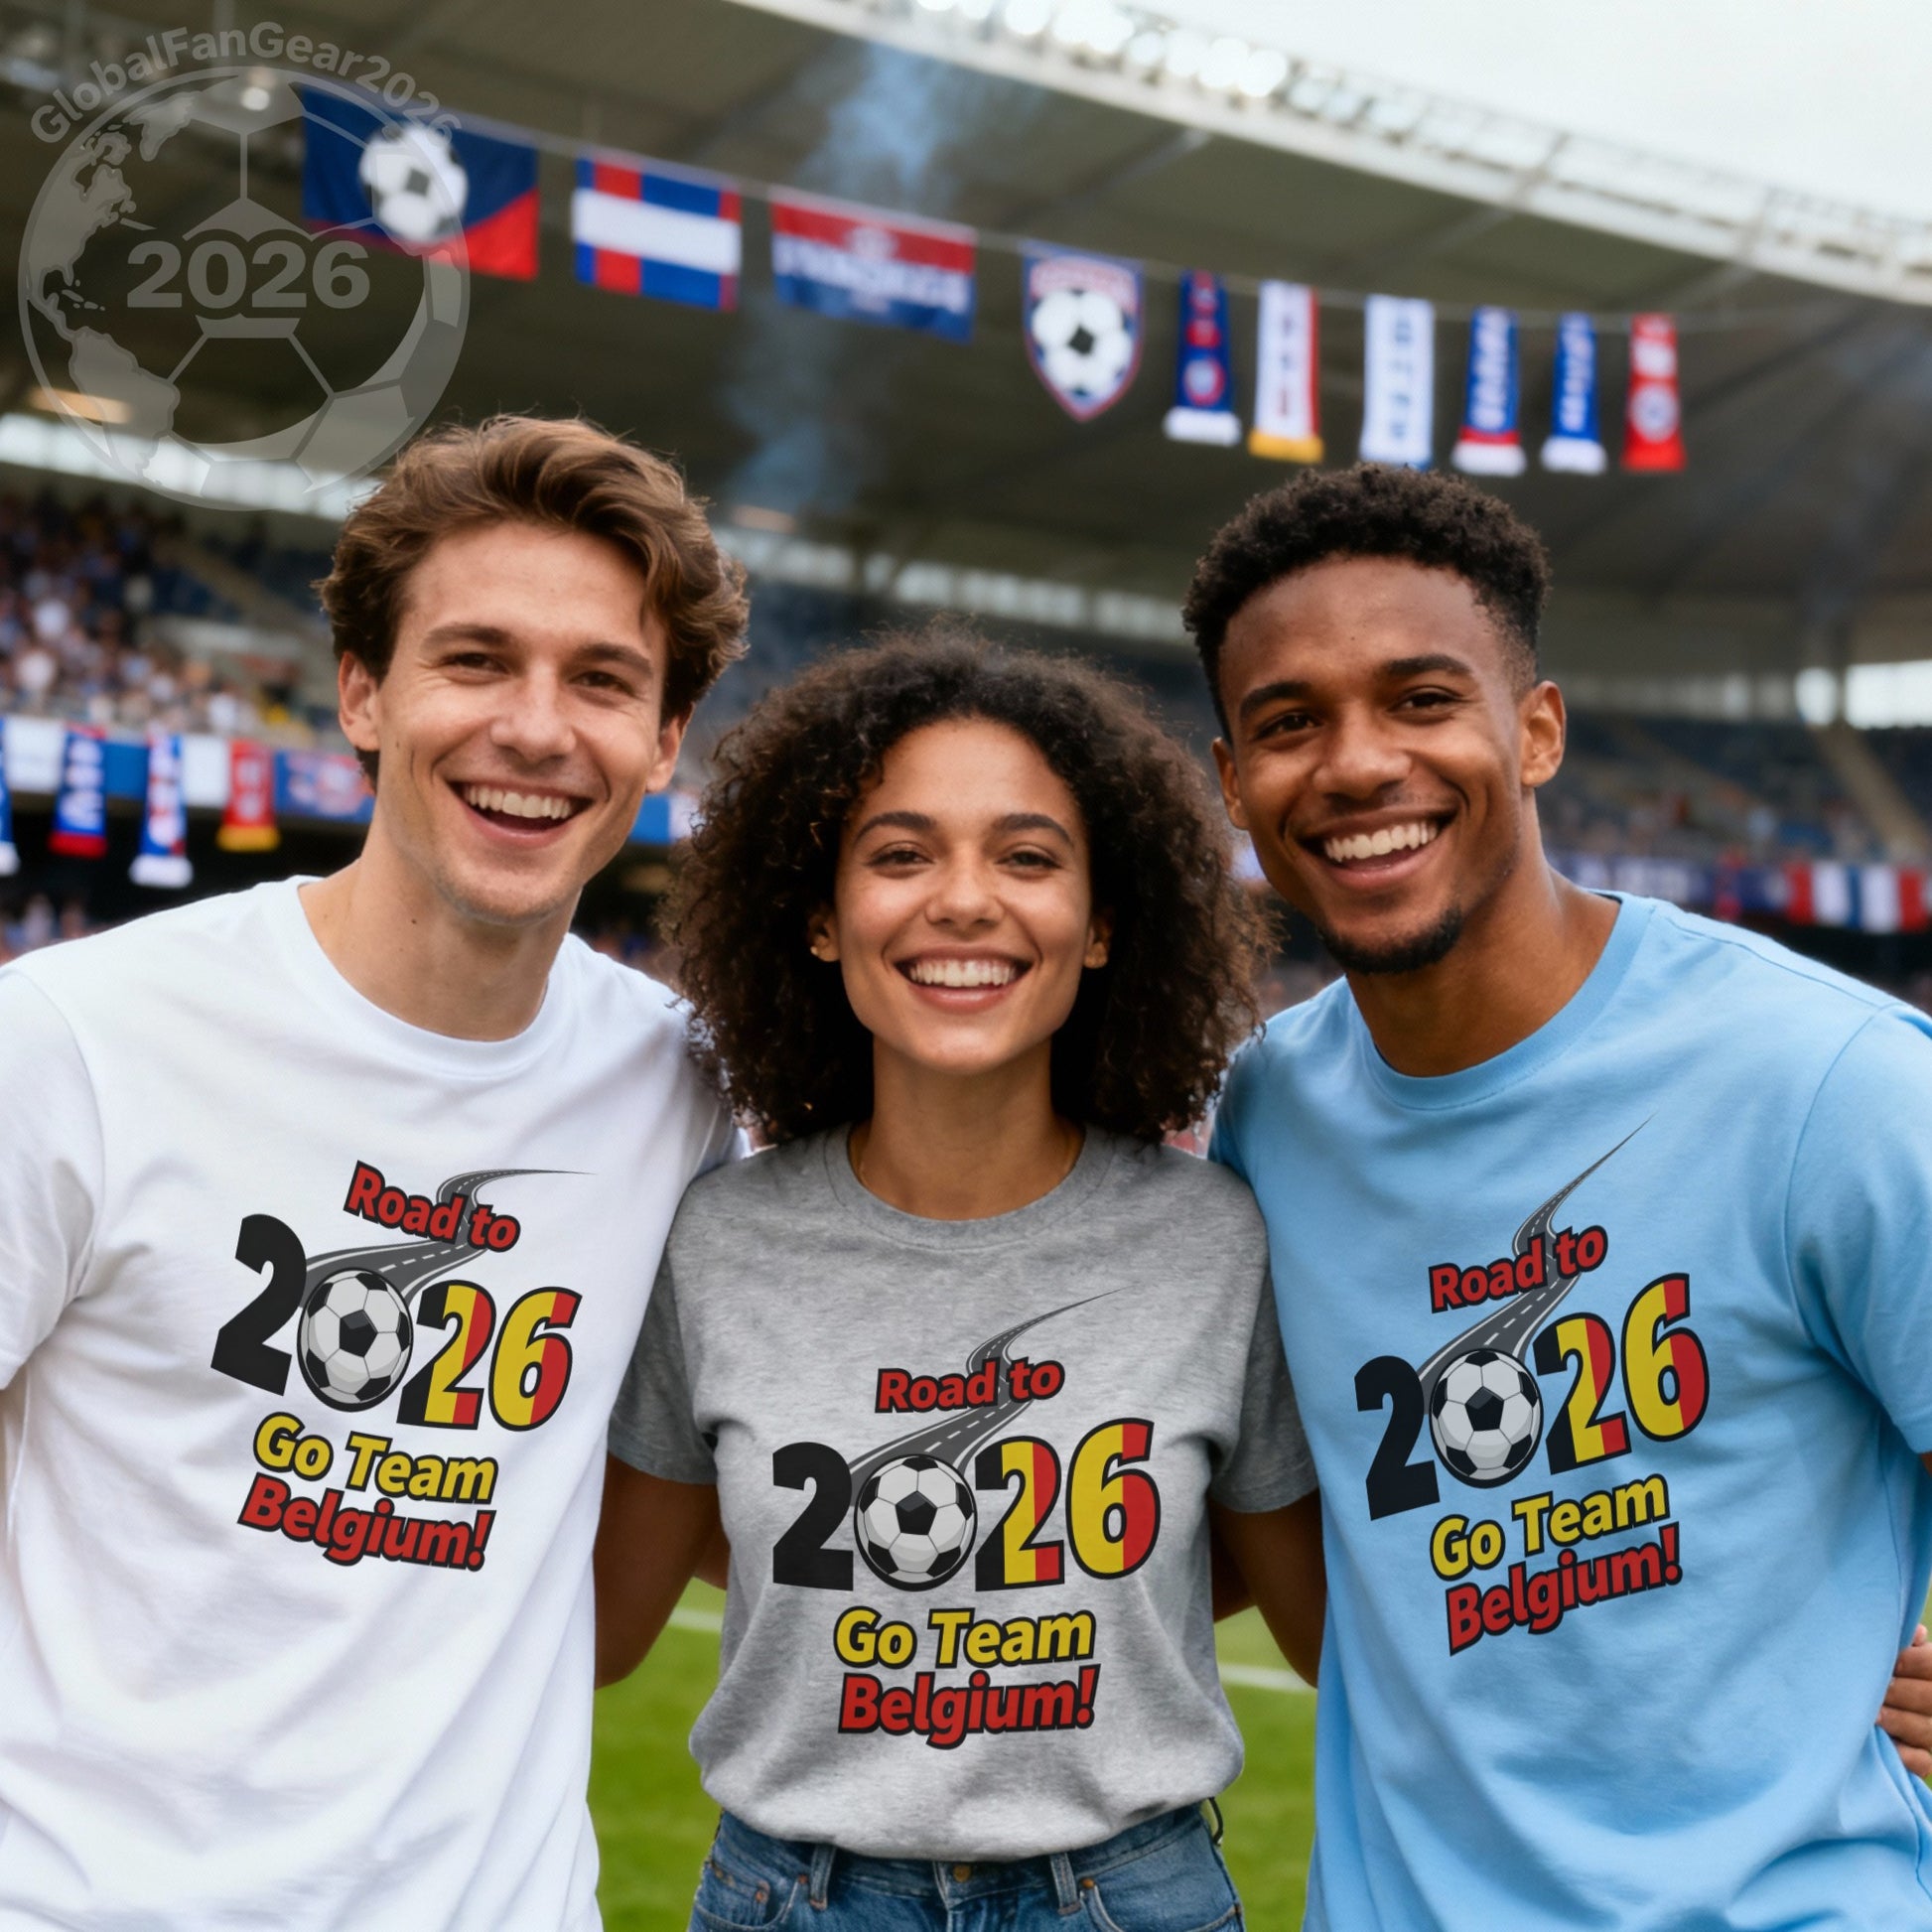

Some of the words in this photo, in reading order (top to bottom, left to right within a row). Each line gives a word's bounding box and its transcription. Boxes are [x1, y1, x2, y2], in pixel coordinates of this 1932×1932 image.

[343, 1160, 470, 1244] Road
[470, 1203, 521, 1253] to
[1428, 1232, 1548, 1313] Road
[1553, 1224, 1608, 1278] to
[875, 1357, 1001, 1414] Road
[1007, 1356, 1065, 1401] to
[253, 1411, 334, 1481] Go
[345, 1431, 498, 1504] Team
[236, 1471, 497, 1572] Belgium!
[1430, 1514, 1506, 1582] Go
[1511, 1473, 1670, 1557] Team
[1445, 1521, 1683, 1656] Belgium!
[833, 1605, 917, 1669] Go
[927, 1607, 1096, 1669] Team
[838, 1663, 1101, 1750] Belgium!
